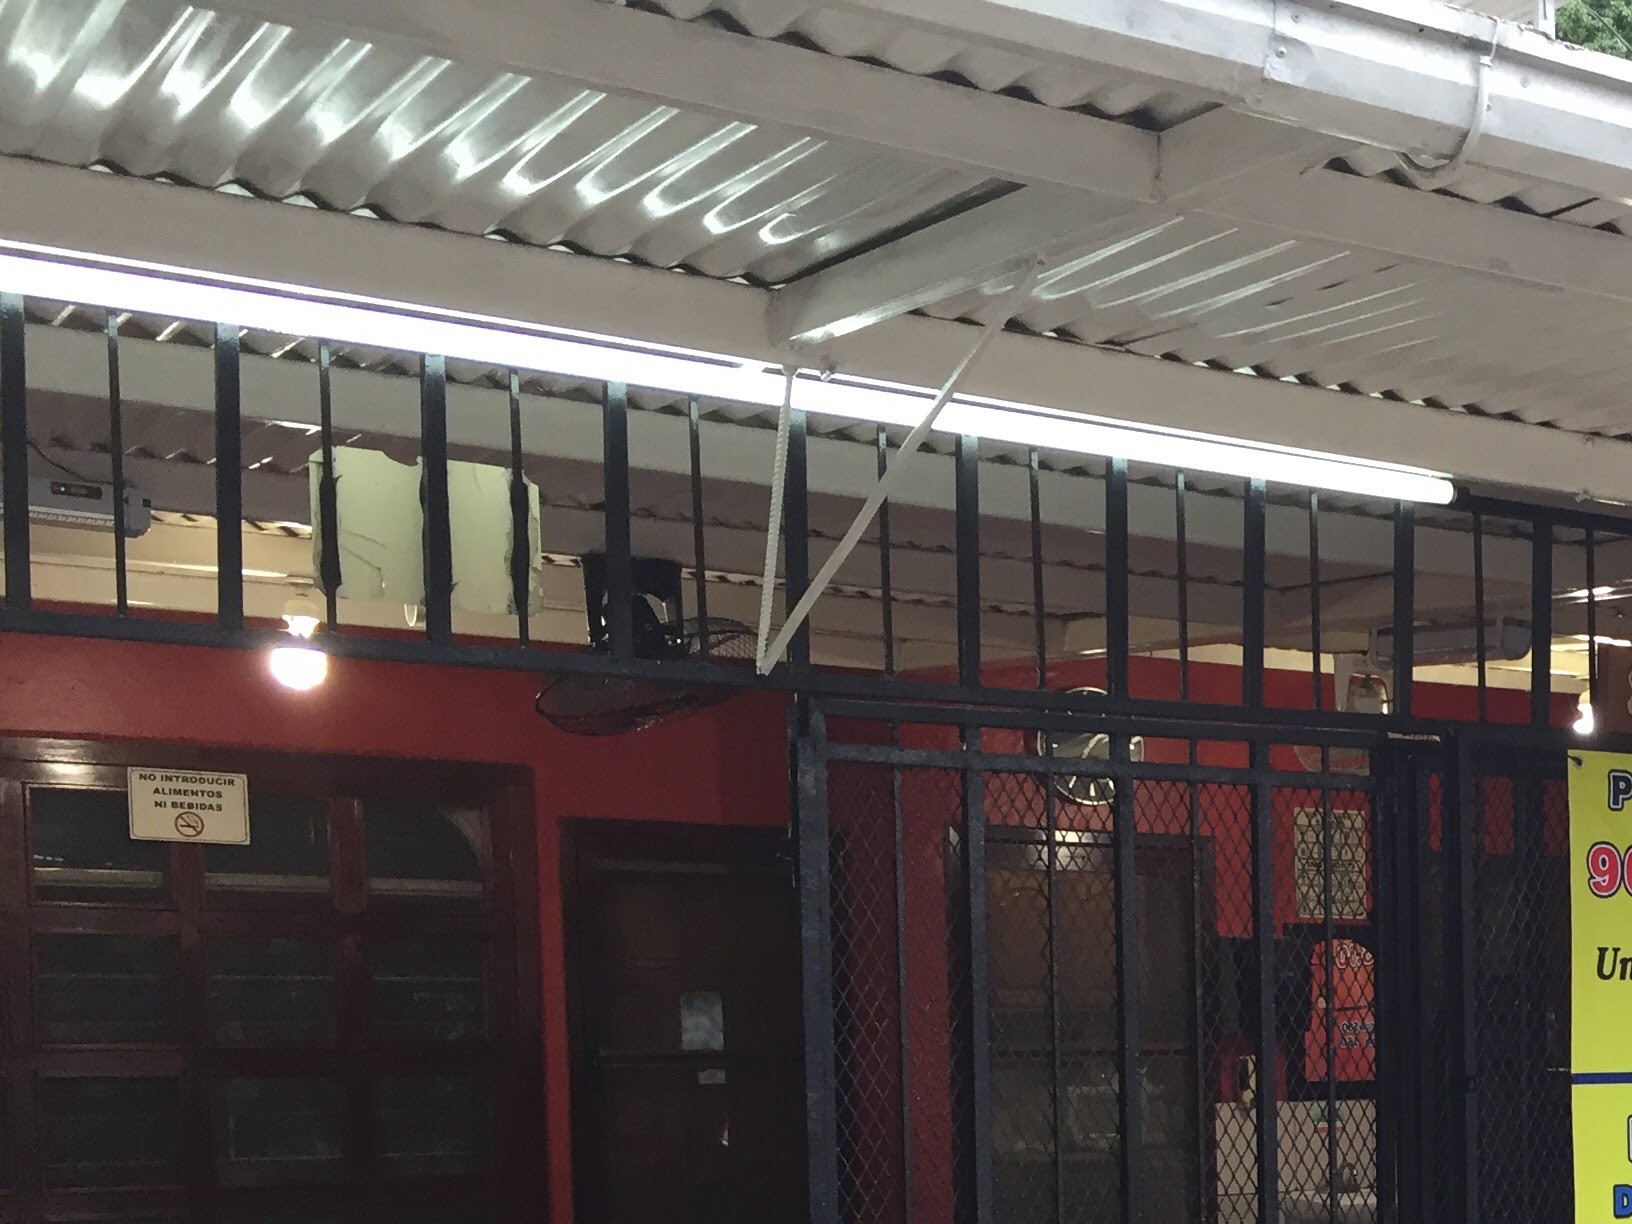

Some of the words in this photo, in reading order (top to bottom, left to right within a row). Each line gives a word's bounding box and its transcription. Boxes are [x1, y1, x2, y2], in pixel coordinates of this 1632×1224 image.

[139, 773, 157, 782] NO
[160, 775, 236, 787] INTRODUCIR
[153, 787, 223, 799] ALIMENTOS
[154, 800, 167, 809] NI
[171, 801, 223, 812] BEBIDAS
